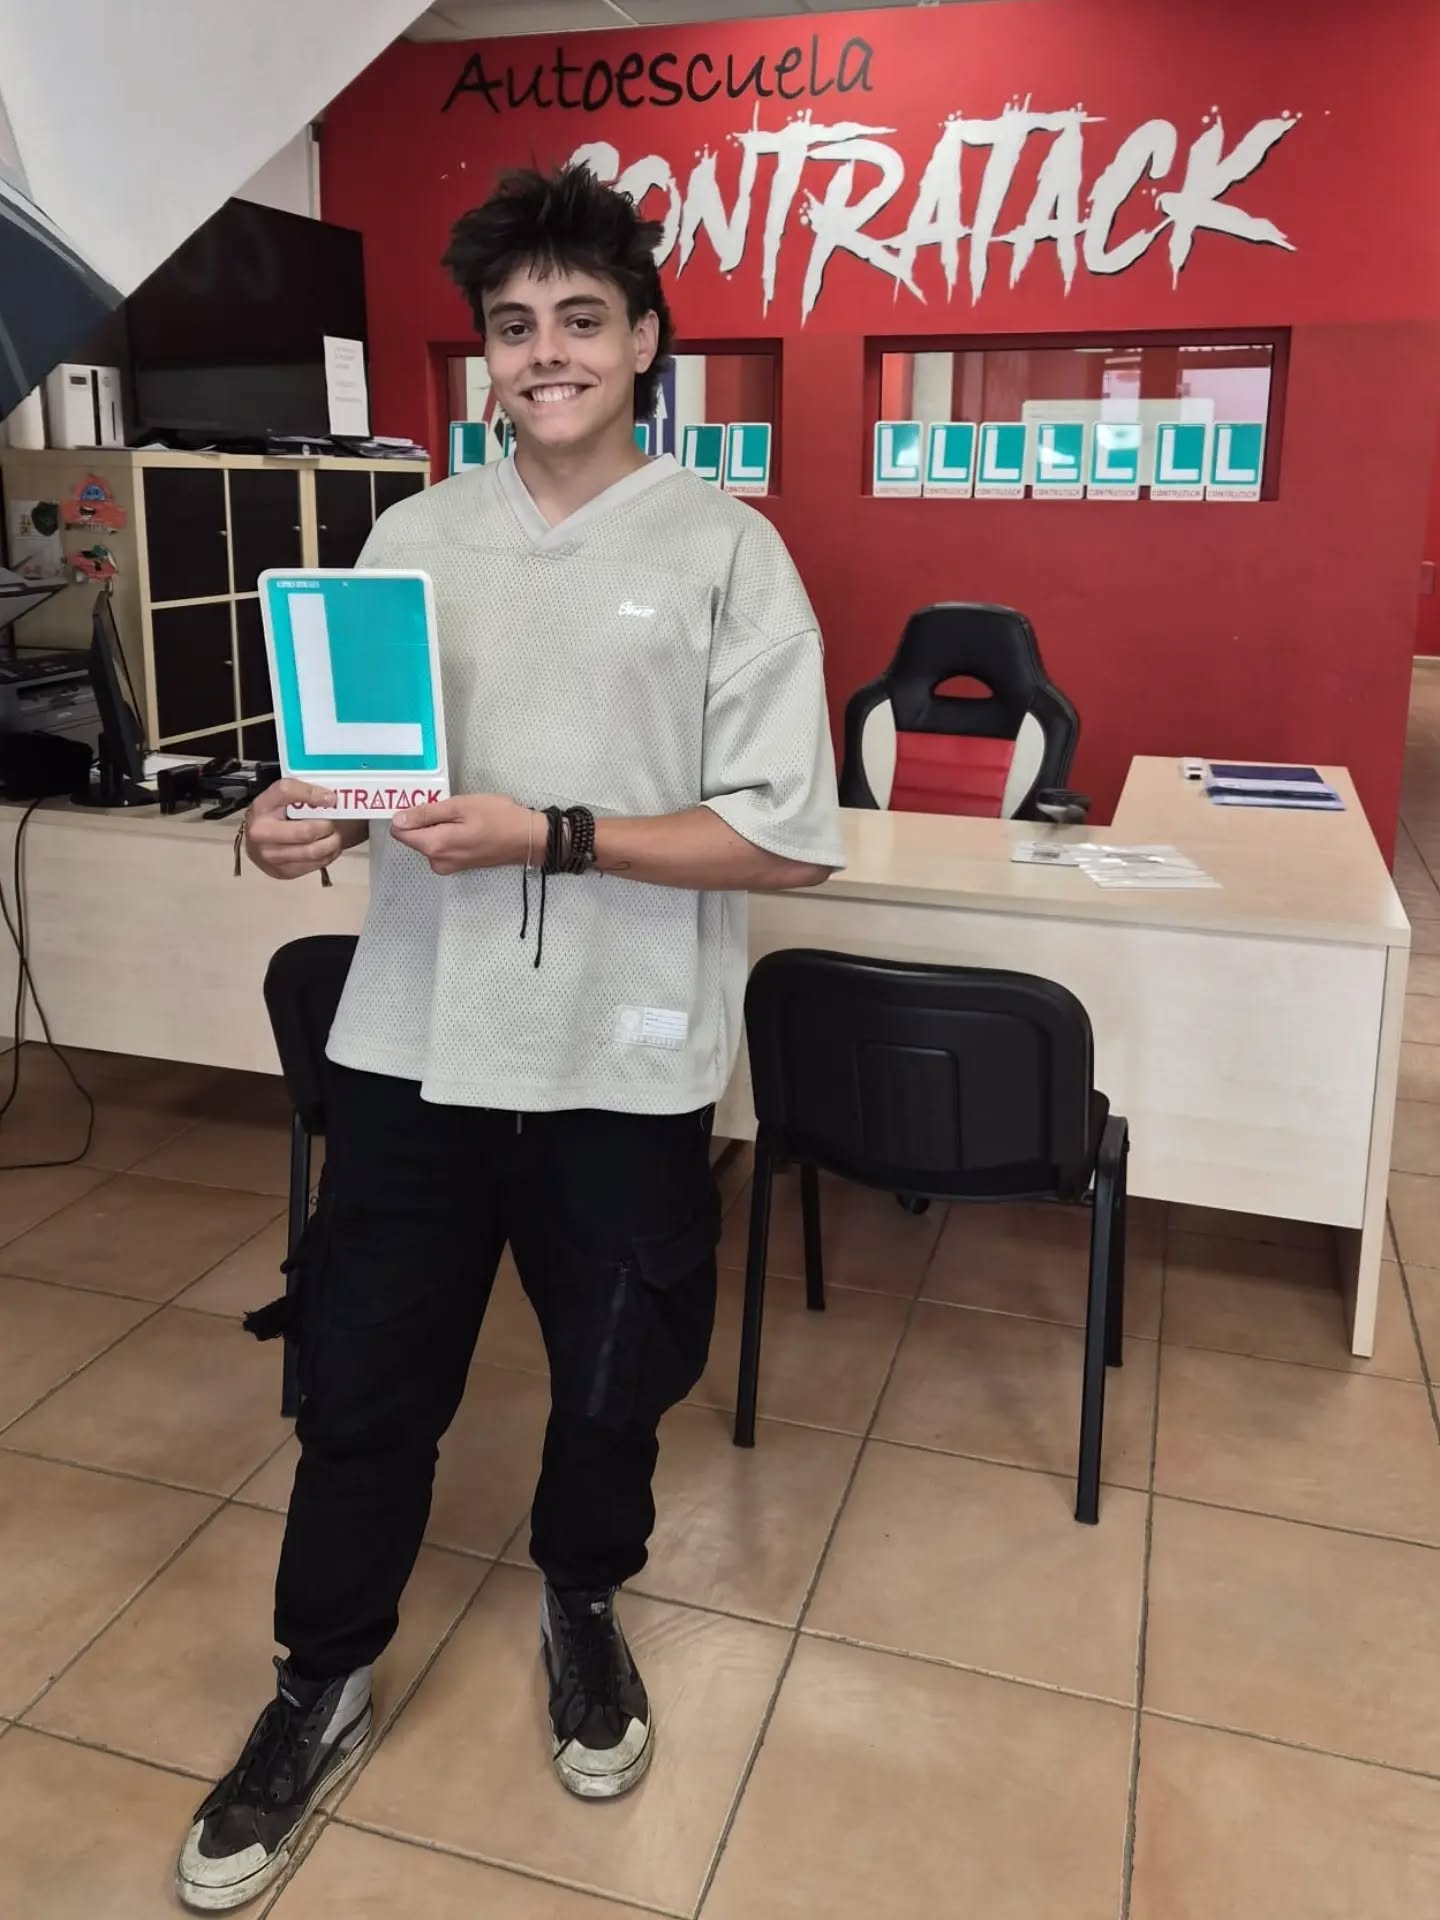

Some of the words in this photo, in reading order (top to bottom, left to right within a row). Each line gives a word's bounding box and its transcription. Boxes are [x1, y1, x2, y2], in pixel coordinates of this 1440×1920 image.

[441, 33, 875, 113] Autoescuela
[685, 430, 716, 477] L
[731, 429, 763, 477] L
[880, 428, 917, 478] L
[931, 429, 967, 478] L
[982, 429, 1019, 479] L
[1040, 428, 1077, 479] L
[1159, 429, 1200, 480] L
[1215, 428, 1255, 480] L
[288, 593, 424, 755] L
[291, 789, 442, 810] TRATACK
